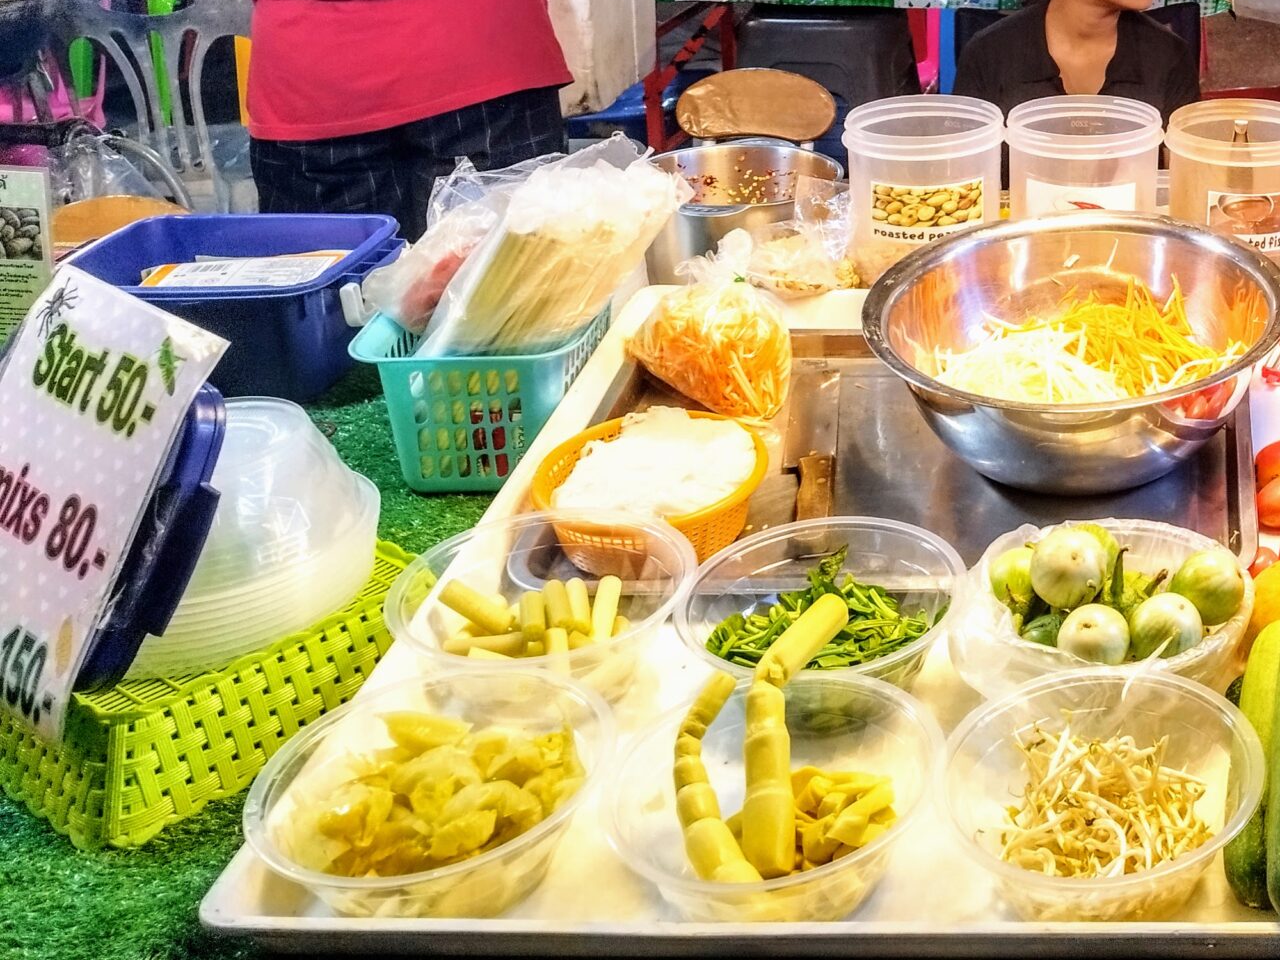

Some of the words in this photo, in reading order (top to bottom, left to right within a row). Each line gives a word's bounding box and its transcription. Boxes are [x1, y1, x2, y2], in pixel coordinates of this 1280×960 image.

[873, 228, 925, 241] roasted
[31, 321, 105, 415] Start
[95, 348, 157, 440] 50.-
[45, 492, 109, 581] 80.-
